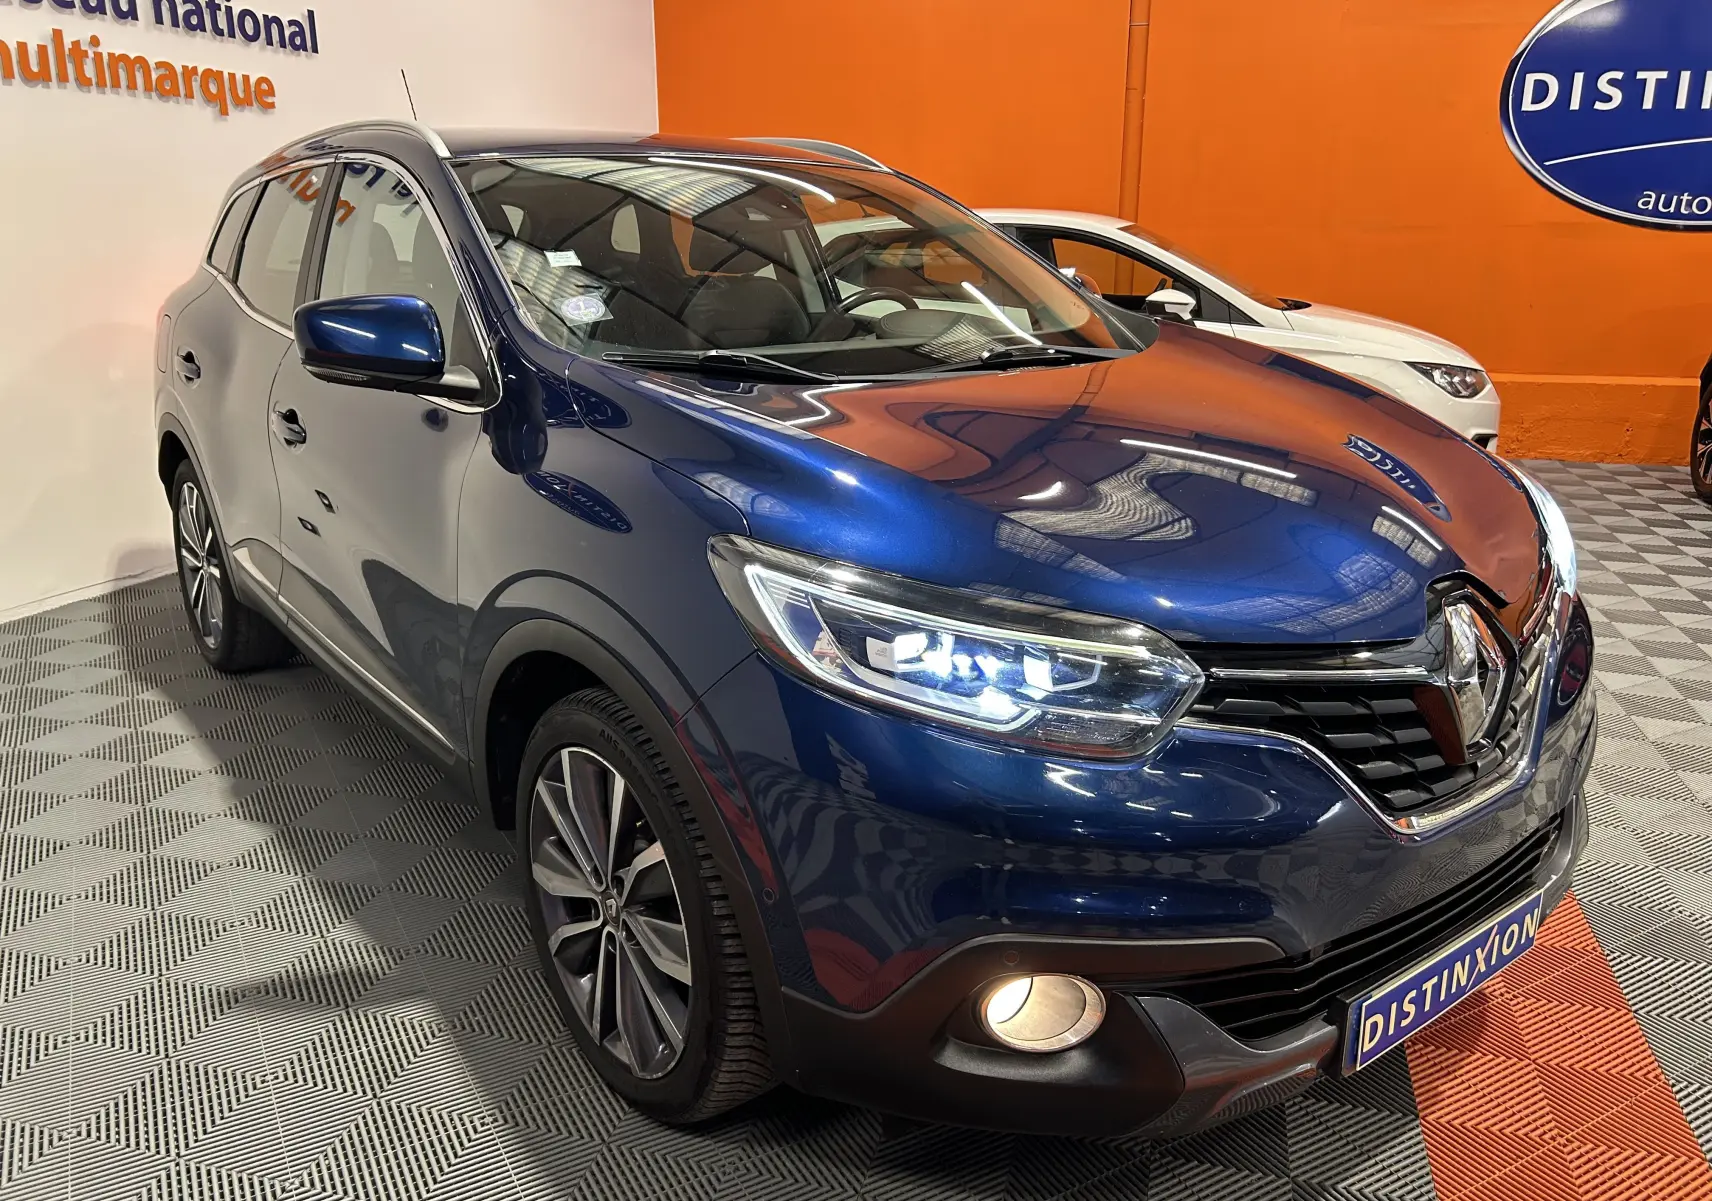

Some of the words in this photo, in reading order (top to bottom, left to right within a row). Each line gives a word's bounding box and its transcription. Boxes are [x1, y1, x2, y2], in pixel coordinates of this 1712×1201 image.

[154, 0, 319, 54] national
[1521, 70, 1712, 112] DISTI
[1637, 191, 1712, 215] auto
[1362, 907, 1538, 1053] DISTINXION
